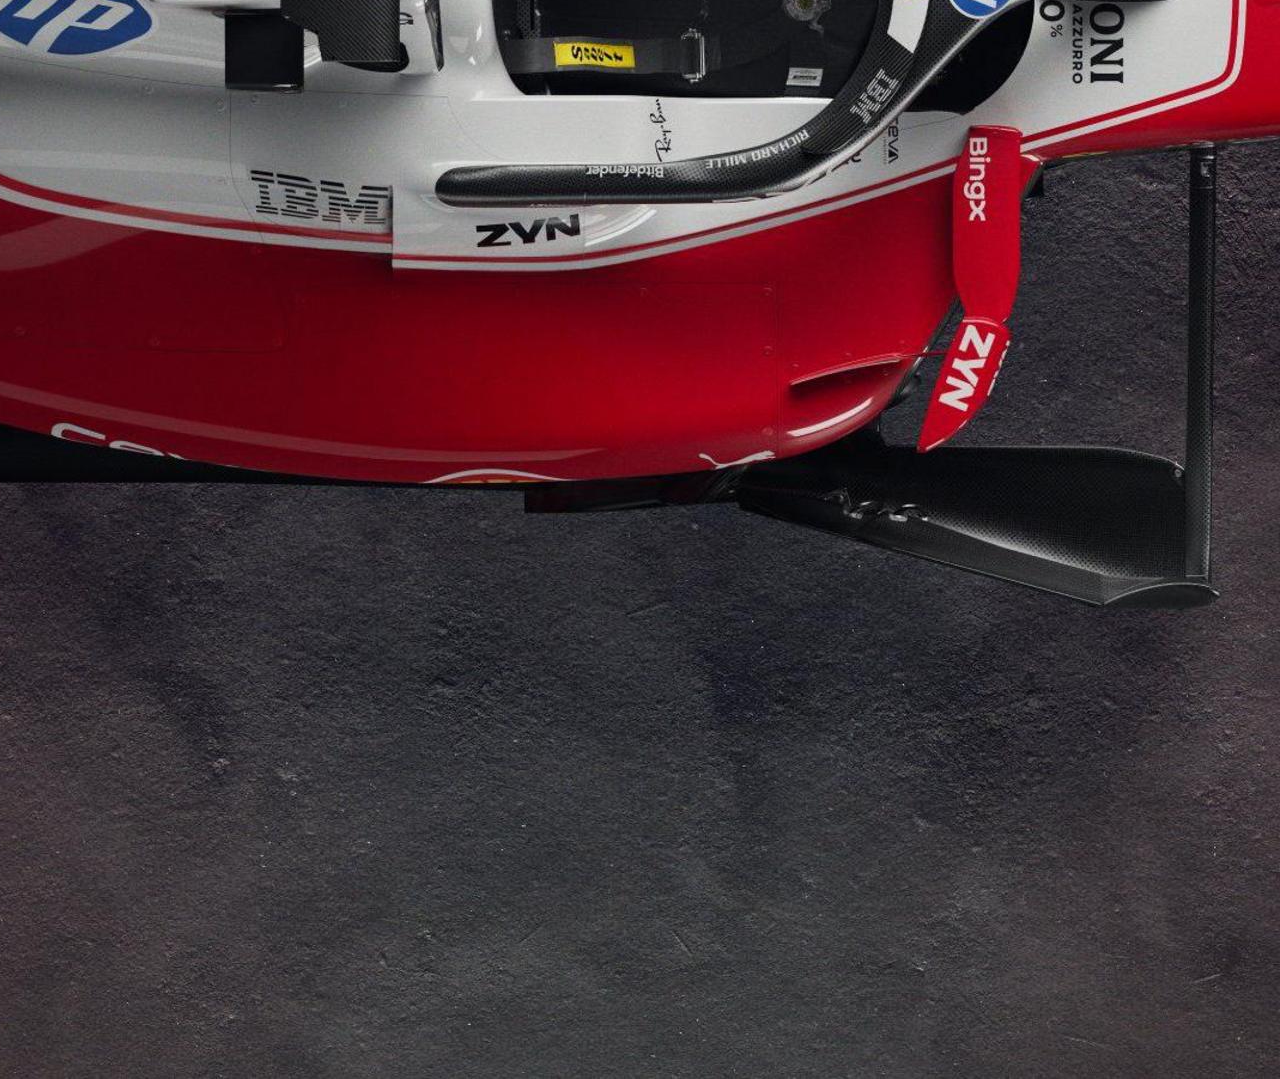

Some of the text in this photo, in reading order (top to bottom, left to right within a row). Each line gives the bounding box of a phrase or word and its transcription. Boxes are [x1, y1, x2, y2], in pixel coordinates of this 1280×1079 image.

[1072, 5, 1083, 84] AZZURRO
[849, 68, 900, 124] IBM
[705, 153, 747, 169] MILLE
[751, 129, 810, 162] RICHARD
[586, 164, 665, 178] Bitdefender
[250, 169, 389, 226] IBM
[475, 213, 581, 248] ZYN
[939, 324, 995, 411] ZYN
